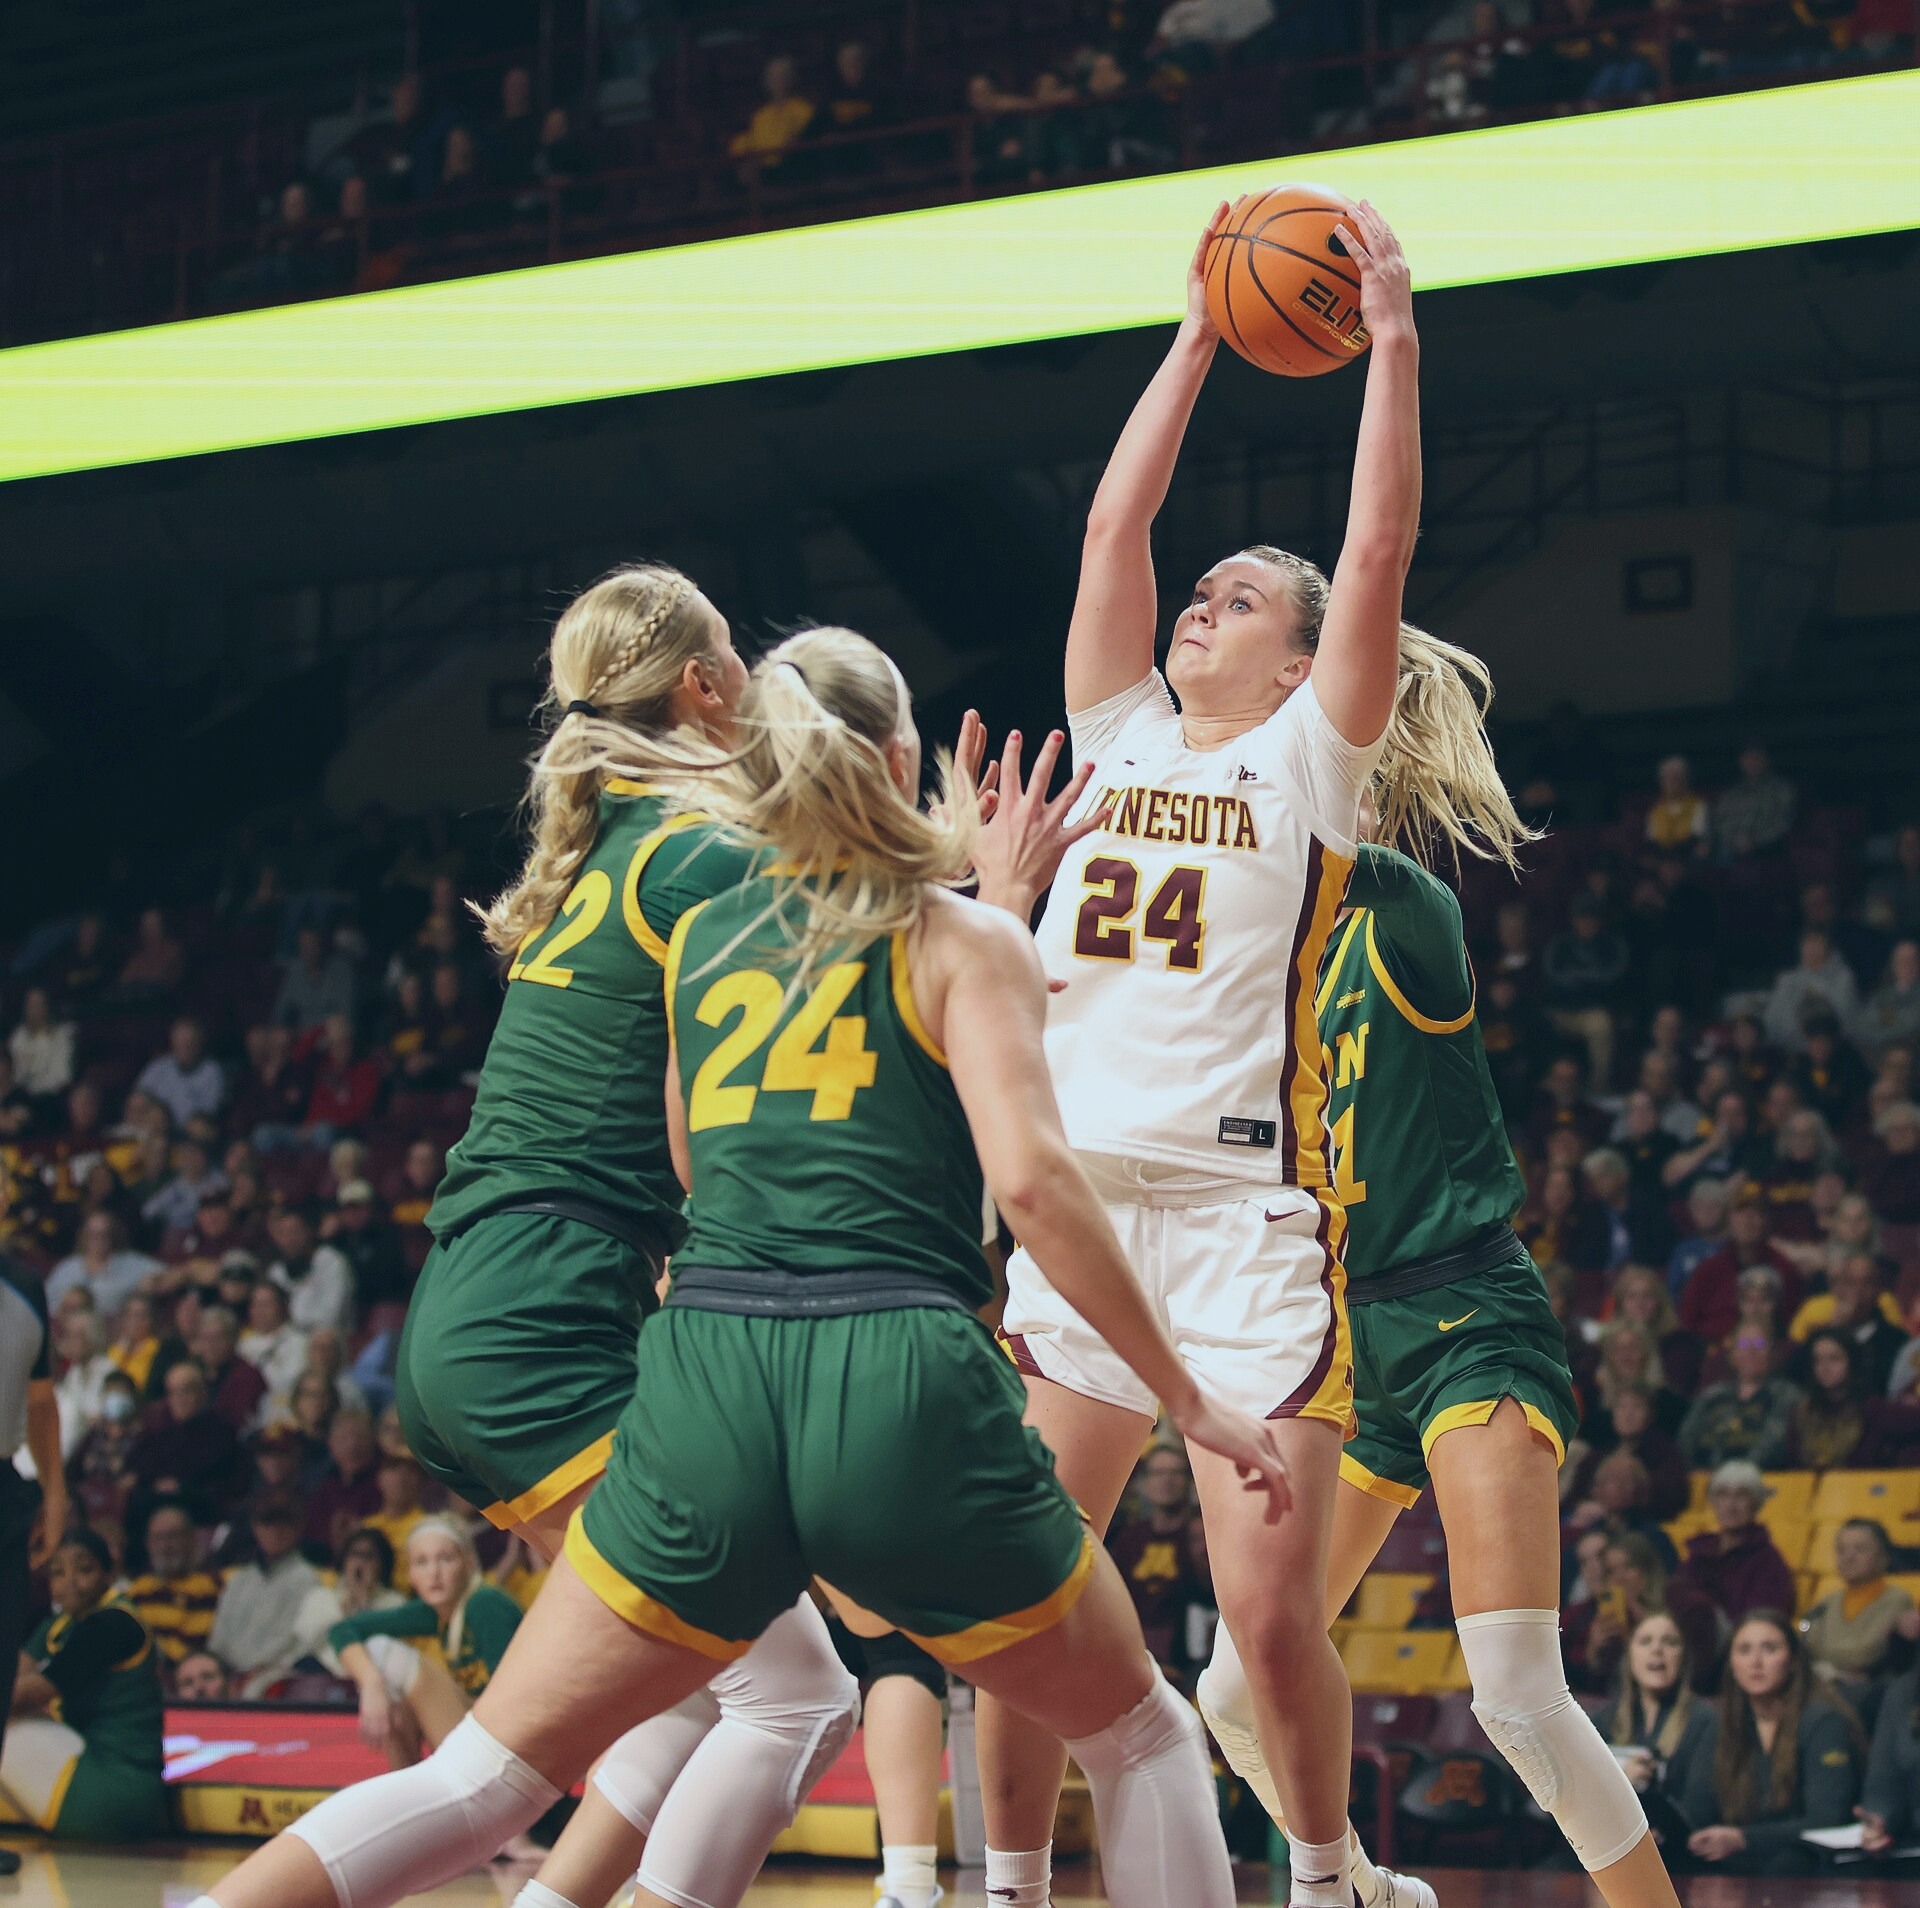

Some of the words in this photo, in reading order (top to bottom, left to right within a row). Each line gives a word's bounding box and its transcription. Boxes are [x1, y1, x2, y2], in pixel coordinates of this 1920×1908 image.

[1298, 277, 1371, 345] ELITE
[1073, 853, 1209, 974] 24
[689, 961, 878, 1133] 24
[1322, 1021, 1370, 1089] N
[1258, 1128, 1266, 1140] L
